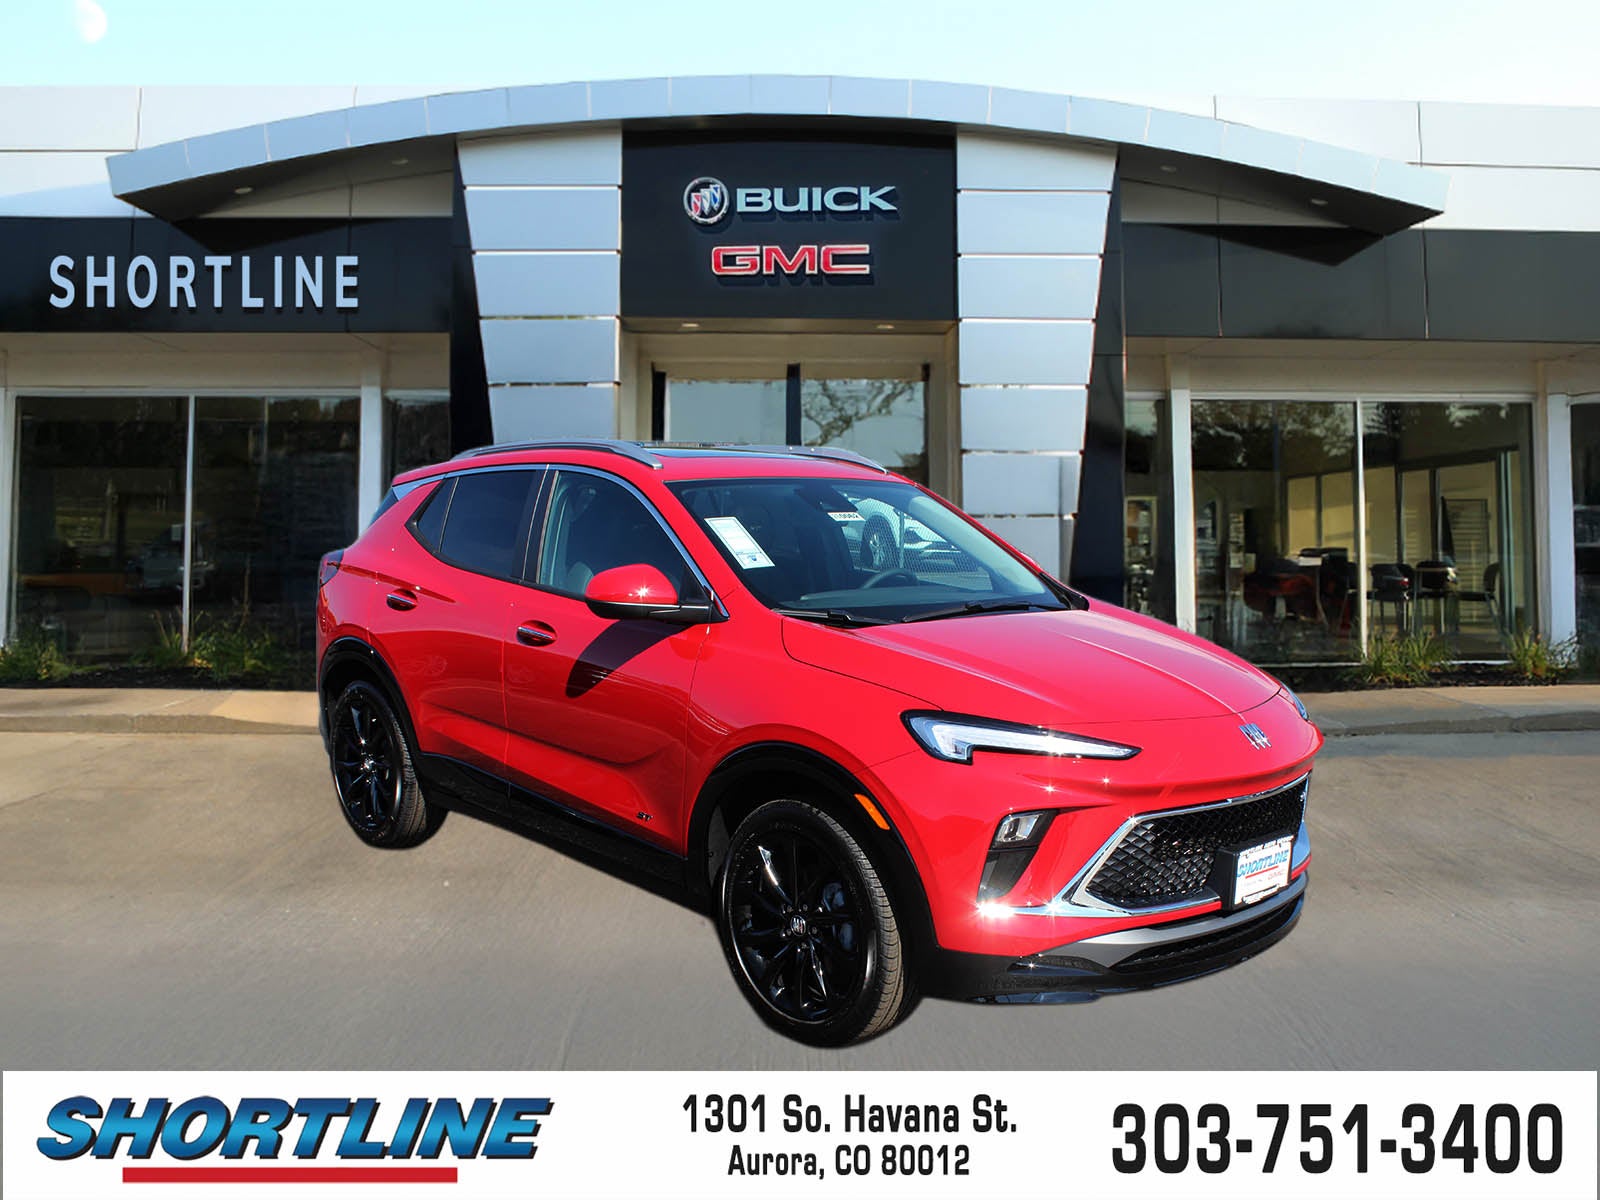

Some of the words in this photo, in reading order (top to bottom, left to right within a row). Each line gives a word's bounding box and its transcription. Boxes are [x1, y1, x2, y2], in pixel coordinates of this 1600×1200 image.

[736, 185, 898, 213] BUICK
[712, 243, 870, 275] GMC
[50, 256, 359, 308] SHORTLINE
[1237, 850, 1289, 877] SHORTLINE
